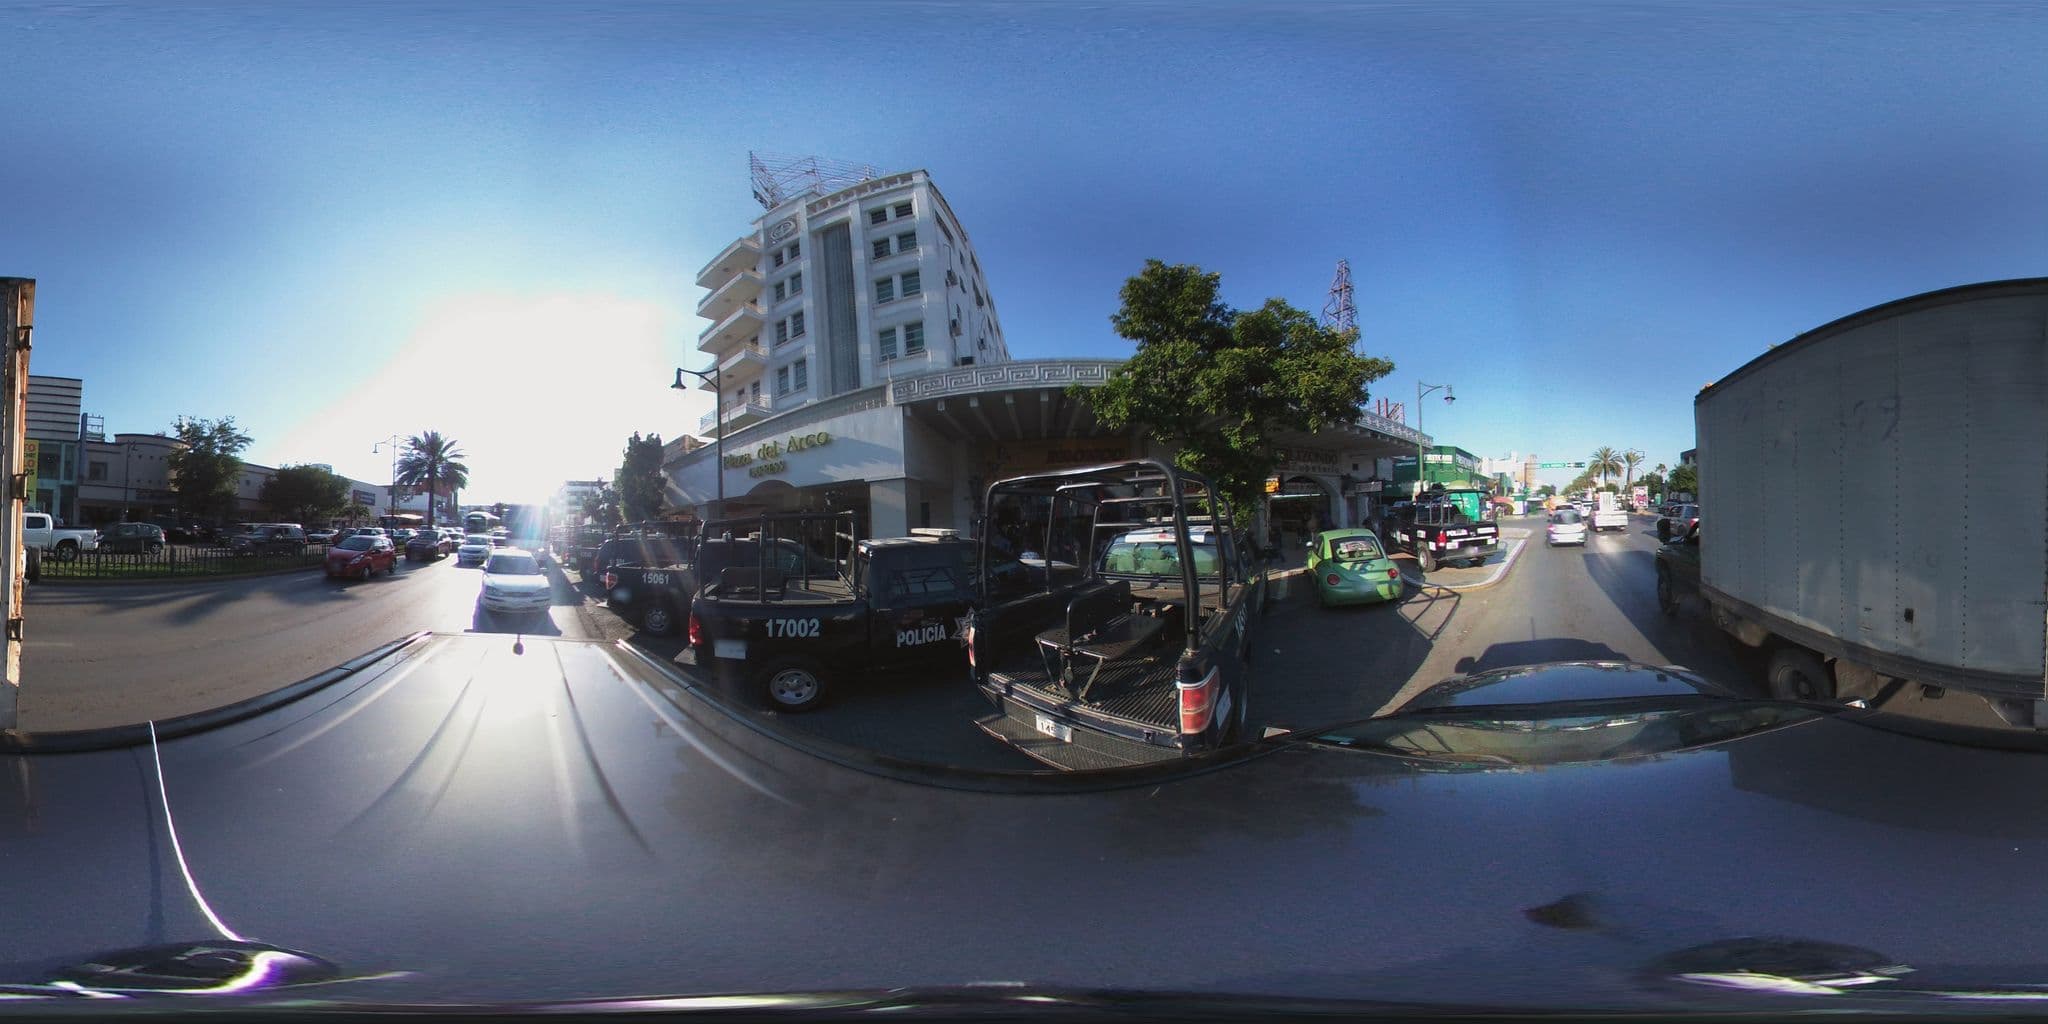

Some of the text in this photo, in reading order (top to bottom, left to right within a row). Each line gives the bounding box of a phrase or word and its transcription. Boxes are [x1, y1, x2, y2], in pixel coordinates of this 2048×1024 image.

[757, 441, 778, 459] del
[785, 432, 829, 453] Arco
[641, 572, 670, 584] 15061
[766, 618, 820, 638] 17002
[896, 623, 947, 648] POLICÍA
